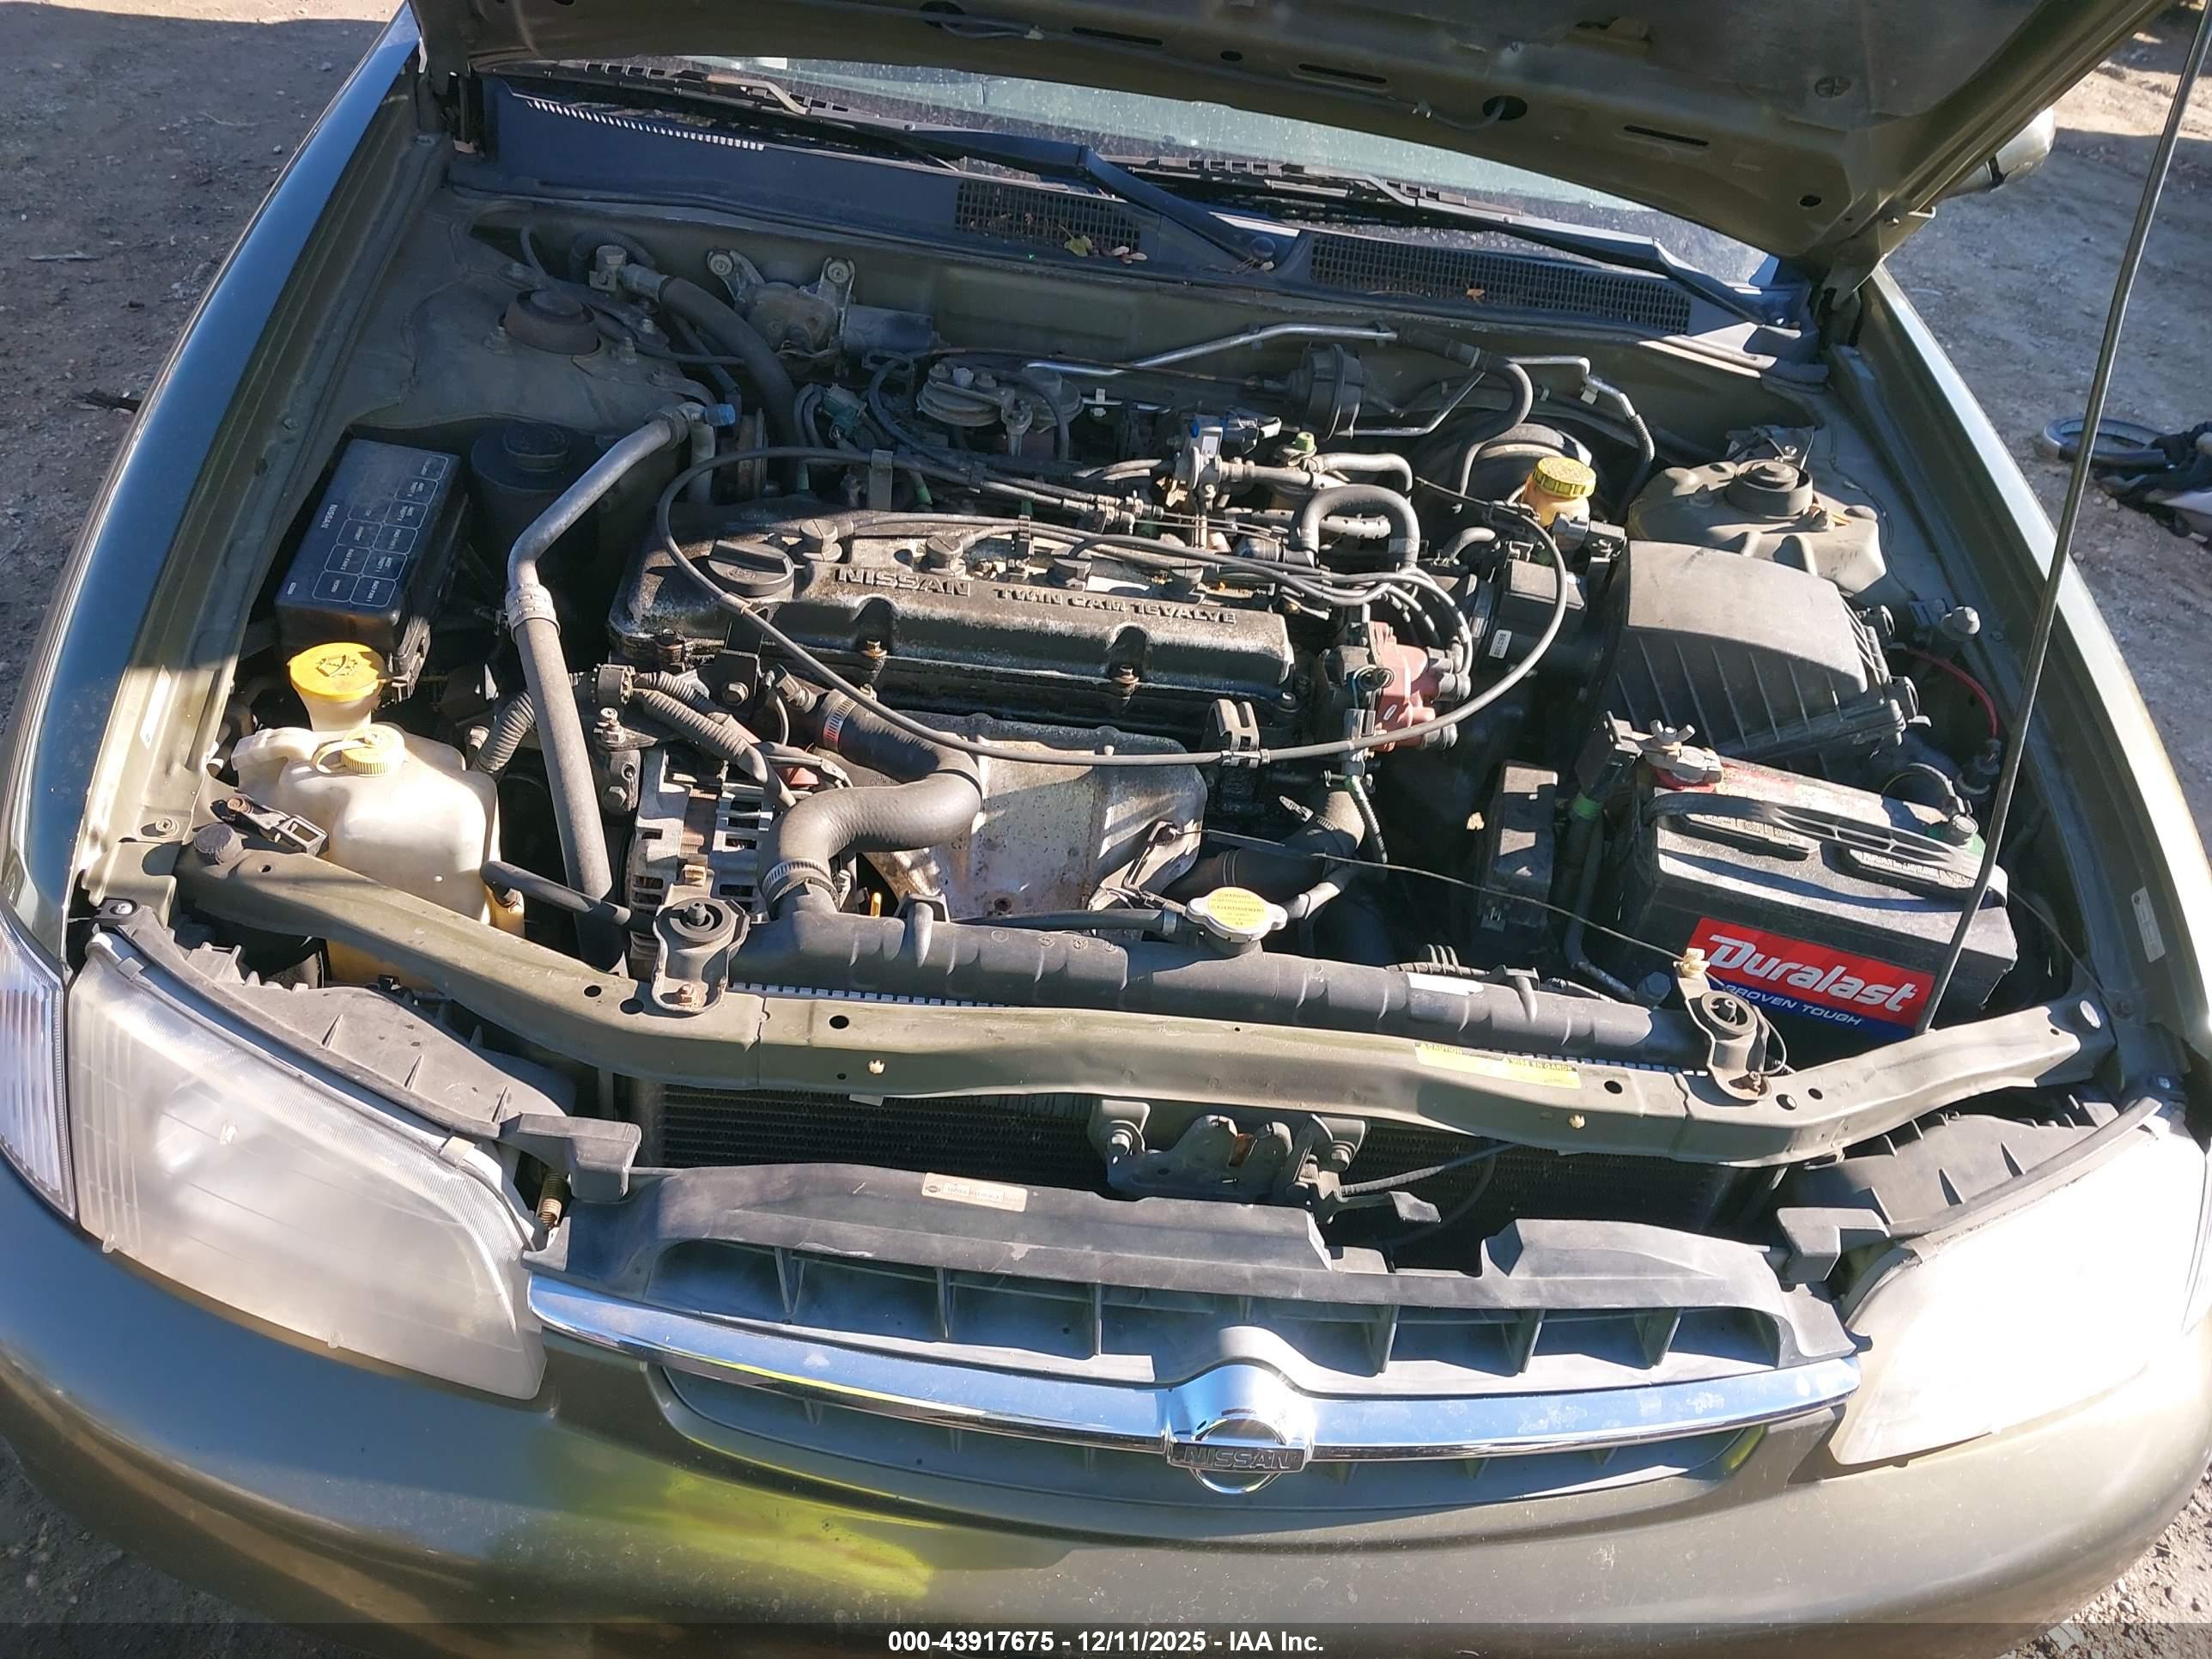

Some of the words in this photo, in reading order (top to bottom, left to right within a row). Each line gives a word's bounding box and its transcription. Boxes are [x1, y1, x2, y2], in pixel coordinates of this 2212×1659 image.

[321, 503, 338, 529] NISSAN
[835, 567, 970, 598] NISSAN
[994, 588, 1062, 605] TWIN
[1068, 596, 1126, 613] CAM
[1709, 934, 1918, 1013] Duralast
[1724, 984, 1798, 1010] PROVEN
[1802, 1005, 1863, 1026] TOUGH
[1184, 1446, 1291, 1469] NISSAN
